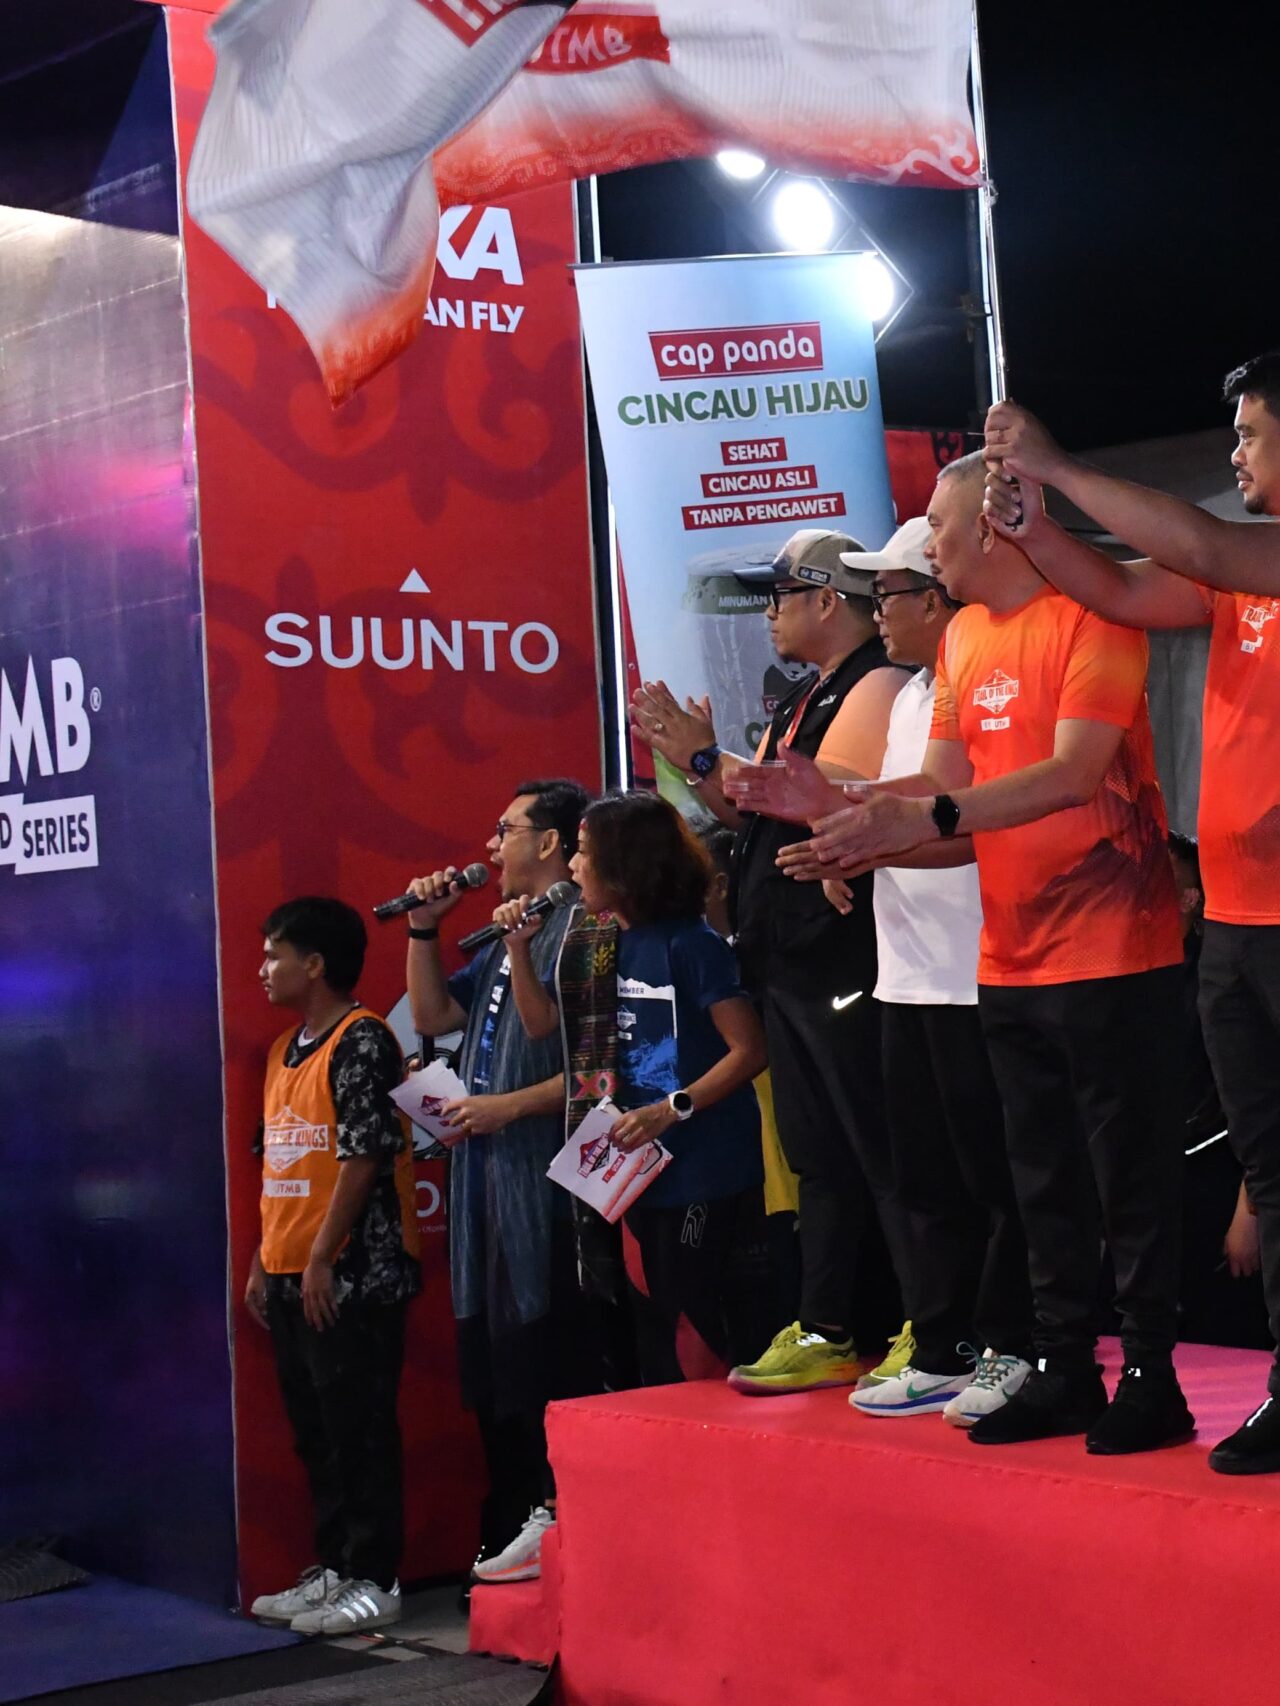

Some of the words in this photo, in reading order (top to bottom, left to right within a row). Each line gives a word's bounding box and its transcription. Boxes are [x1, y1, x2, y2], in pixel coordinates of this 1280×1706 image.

[436, 204, 524, 286] KA
[424, 297, 465, 328] AN
[471, 301, 524, 333] FLY
[660, 343, 714, 372] cap
[723, 330, 815, 370] panda
[617, 388, 756, 426] CINCAU
[765, 379, 868, 416] HIJAU
[728, 442, 779, 461] SEHAT
[708, 473, 771, 494] CINCAU
[775, 470, 810, 487] ASLI
[689, 506, 744, 526] TANPA
[747, 497, 838, 521] PENGAWET
[718, 594, 769, 608] MINUMAN
[264, 612, 560, 674] SUUNTO
[22, 812, 90, 859] SERIES
[295, 1127, 326, 1148] KINGS
